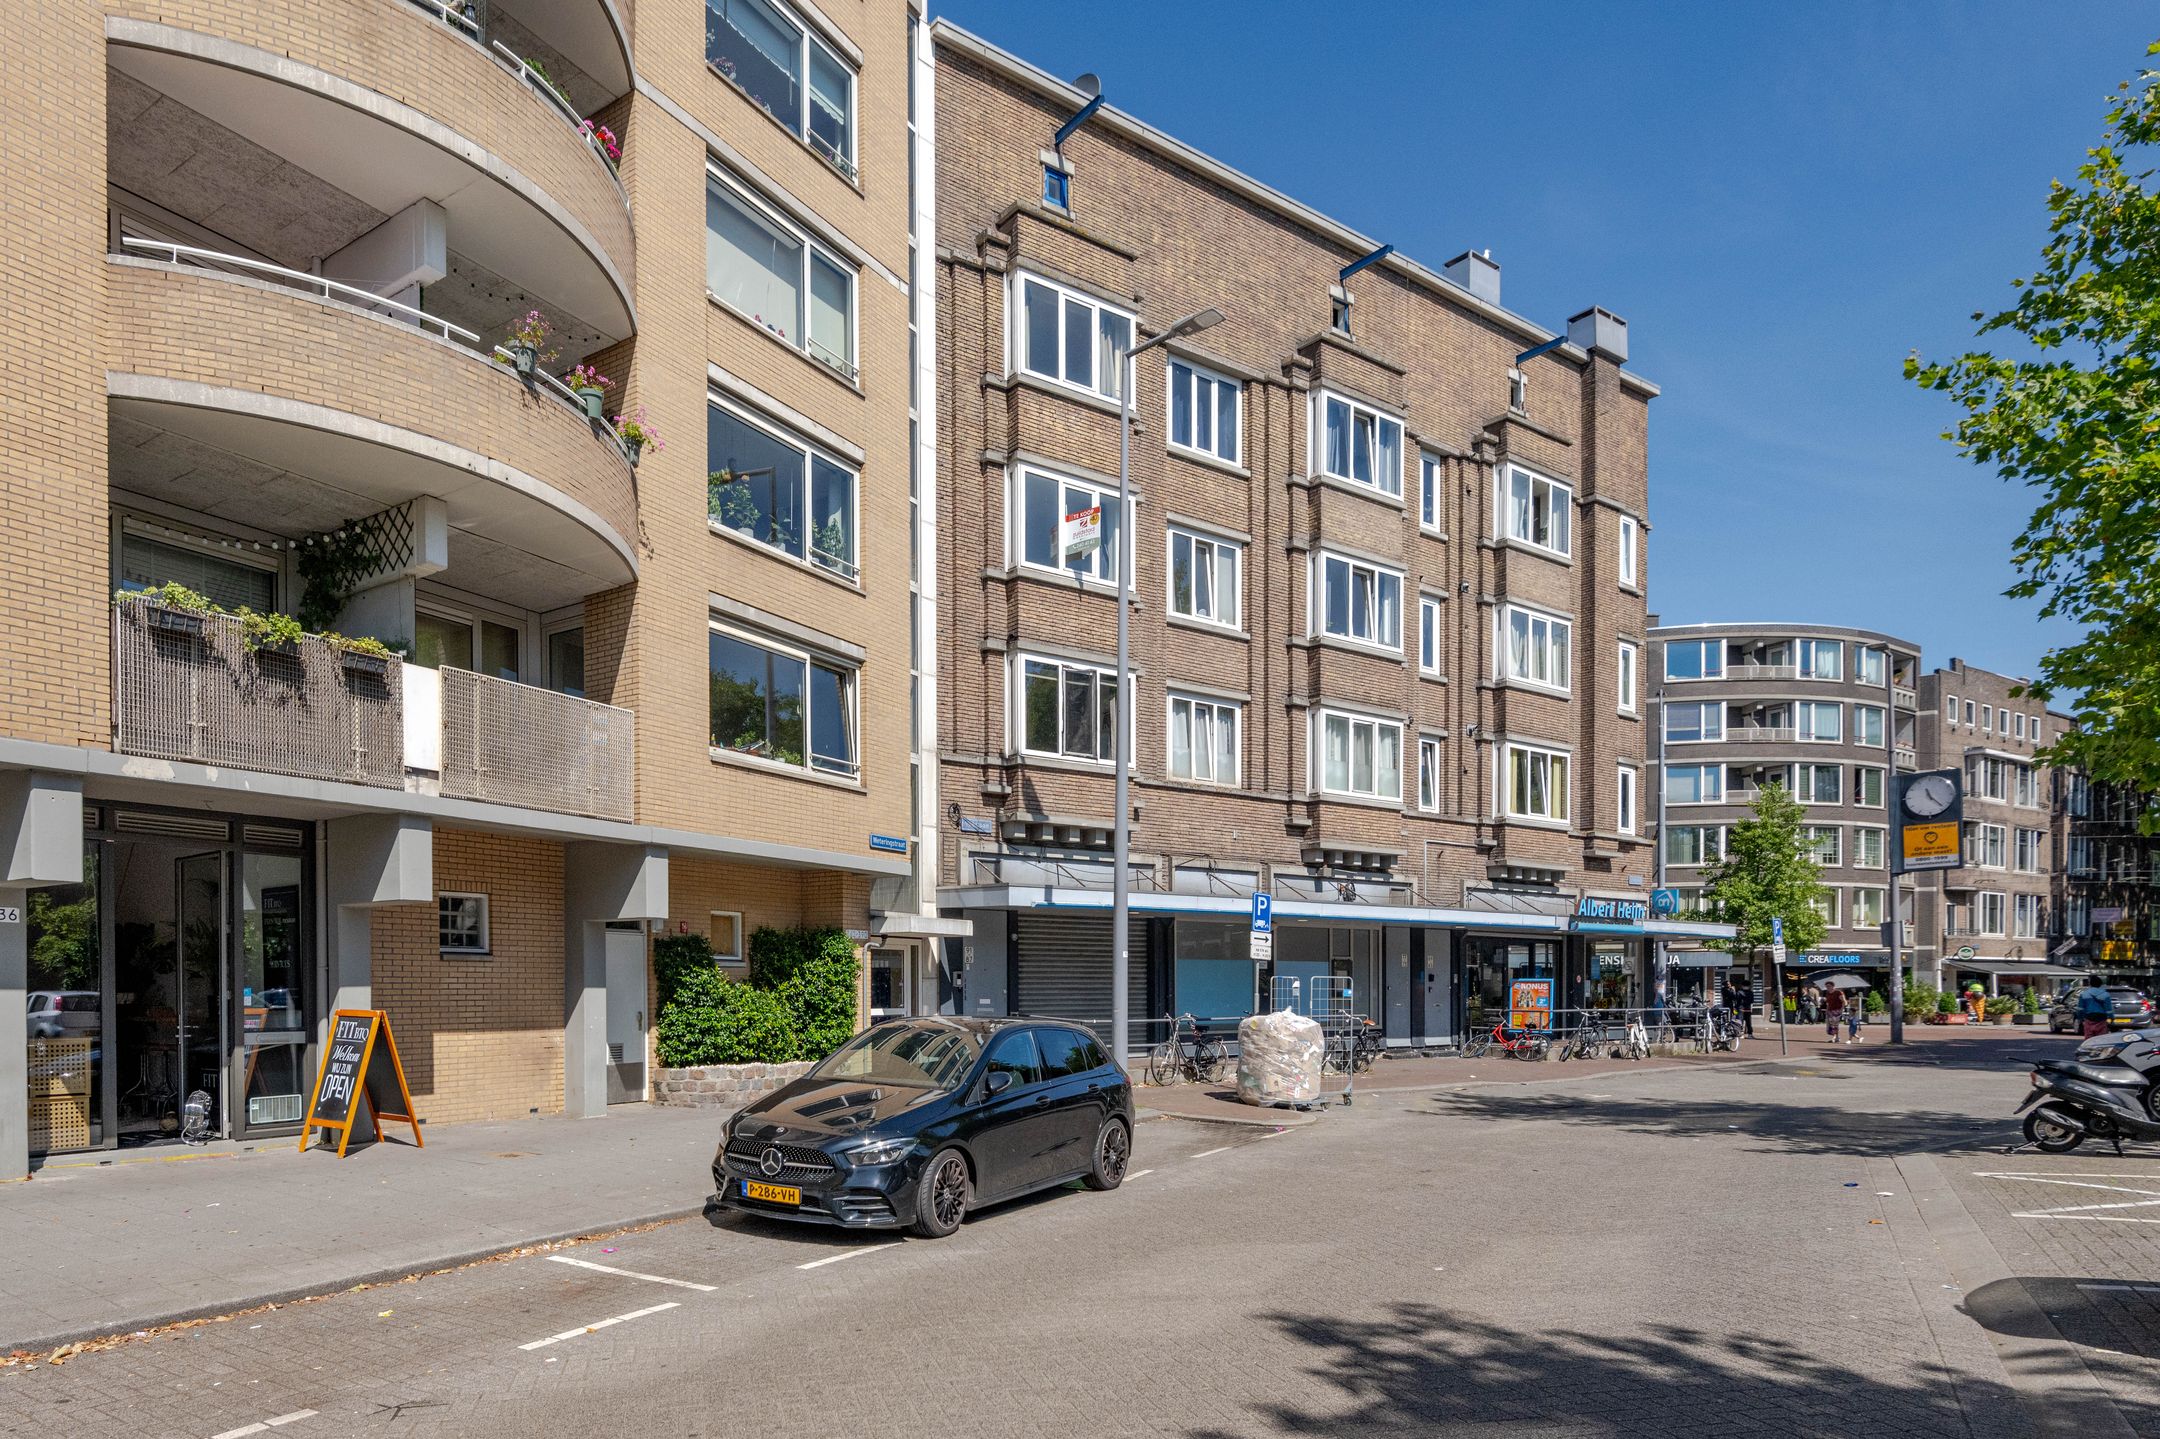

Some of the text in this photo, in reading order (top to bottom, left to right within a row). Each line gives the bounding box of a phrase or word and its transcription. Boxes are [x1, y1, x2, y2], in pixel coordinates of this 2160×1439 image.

[1080, 509, 1095, 517] KOOP
[1257, 896, 1267, 916] P
[1578, 897, 1647, 921] Albert Heijn
[1774, 919, 1781, 934] P
[1808, 955, 1860, 964] CREAFLOORS
[332, 1044, 361, 1063] Welkom
[320, 1073, 356, 1106] OPEN
[749, 1183, 796, 1202] P-286-VH
